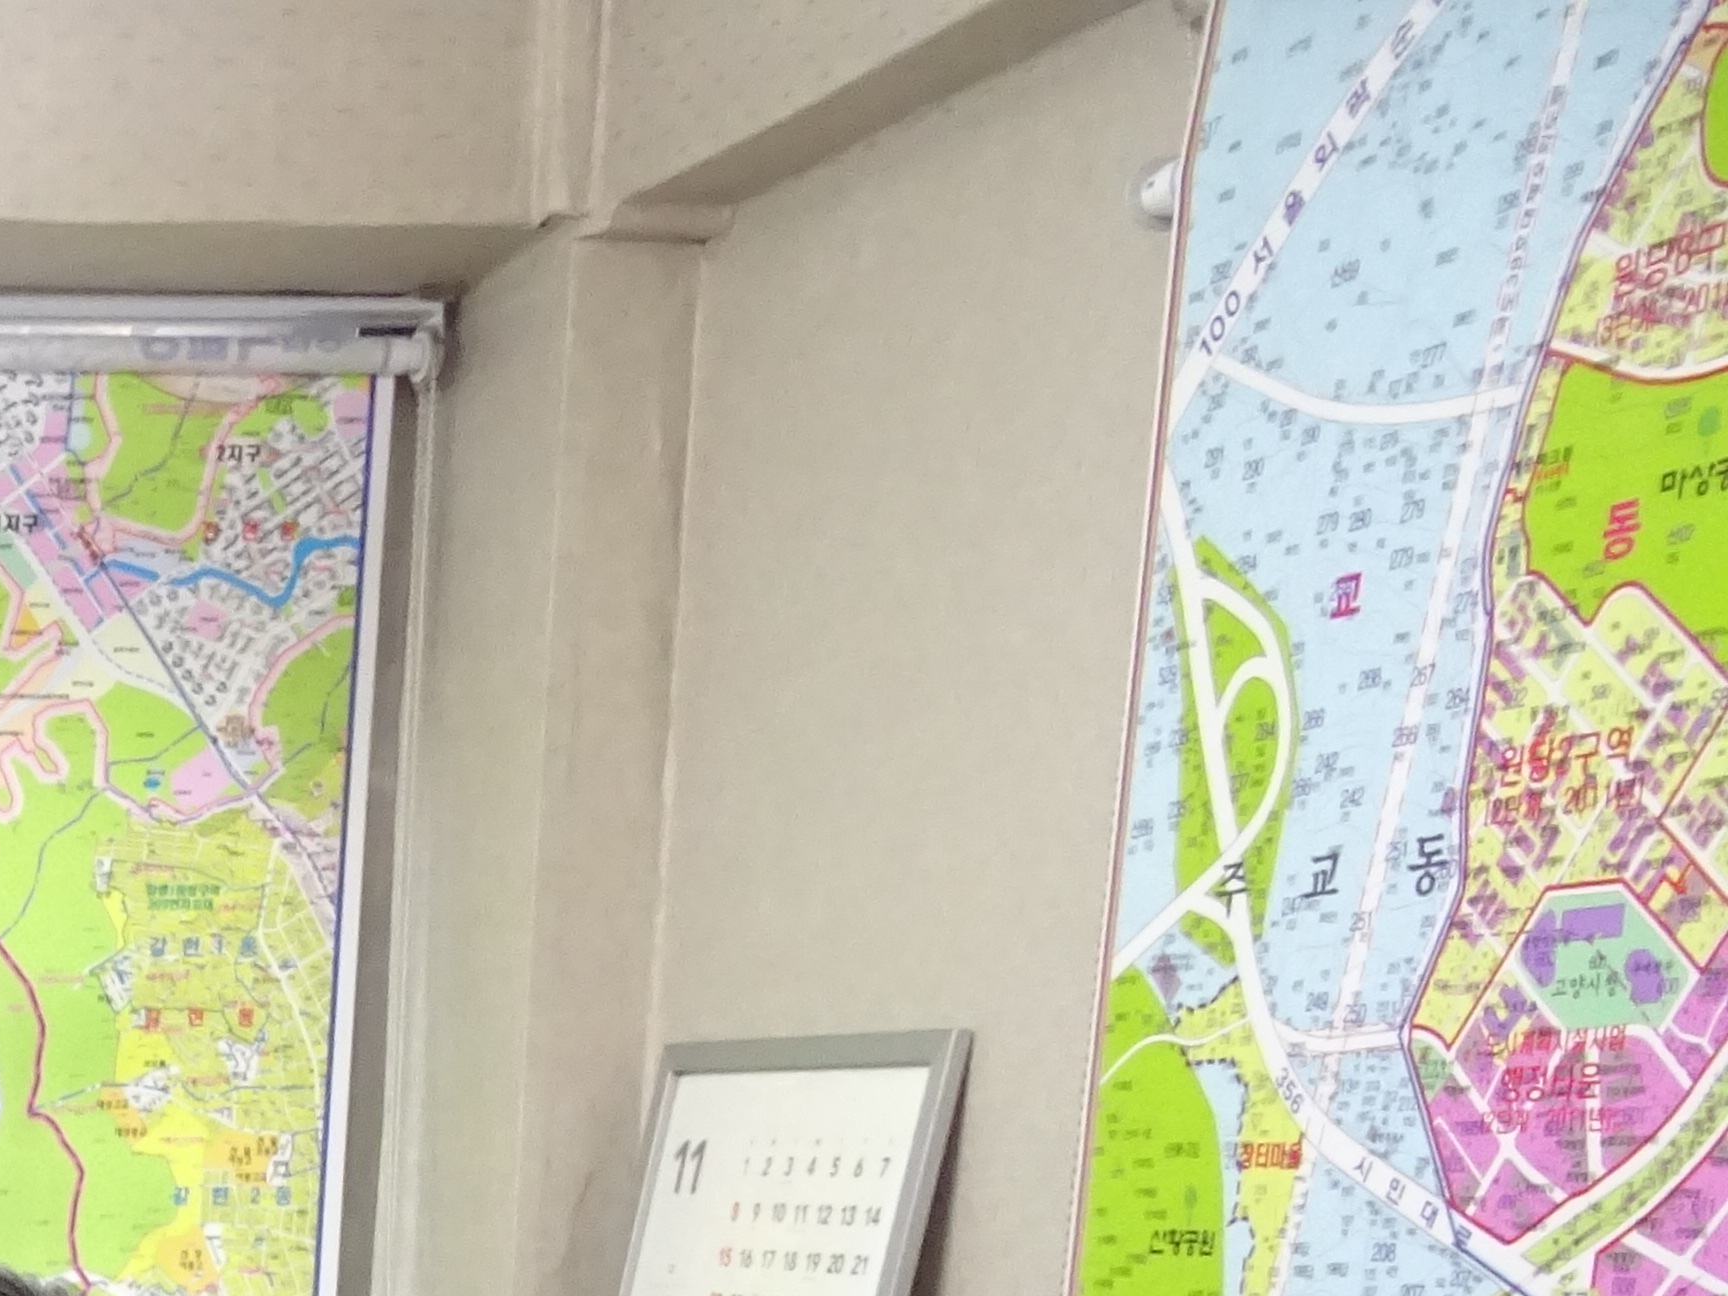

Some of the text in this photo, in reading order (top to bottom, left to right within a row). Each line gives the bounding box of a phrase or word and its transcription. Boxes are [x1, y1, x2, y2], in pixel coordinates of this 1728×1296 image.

[1199, 0, 1434, 357] 100 서울외곽순
[217, 445, 262, 462] 2지구
[1399, 498, 1426, 524] 279
[1410, 662, 1436, 687] 267
[1340, 786, 1366, 809] 242
[1349, 911, 1374, 934] 251
[674, 1139, 708, 1194] 11
[761, 1156, 891, 1178] 2 3 4 5 6 7
[1275, 1066, 1473, 1249] 356 시민대로
[731, 1202, 881, 1226] 8 9 10 11 12 13 14
[1149, 1229, 1216, 1256] 산황공원
[1370, 1242, 1397, 1262] 208
[719, 1248, 868, 1275] 15 16 17 18 19 20 21
